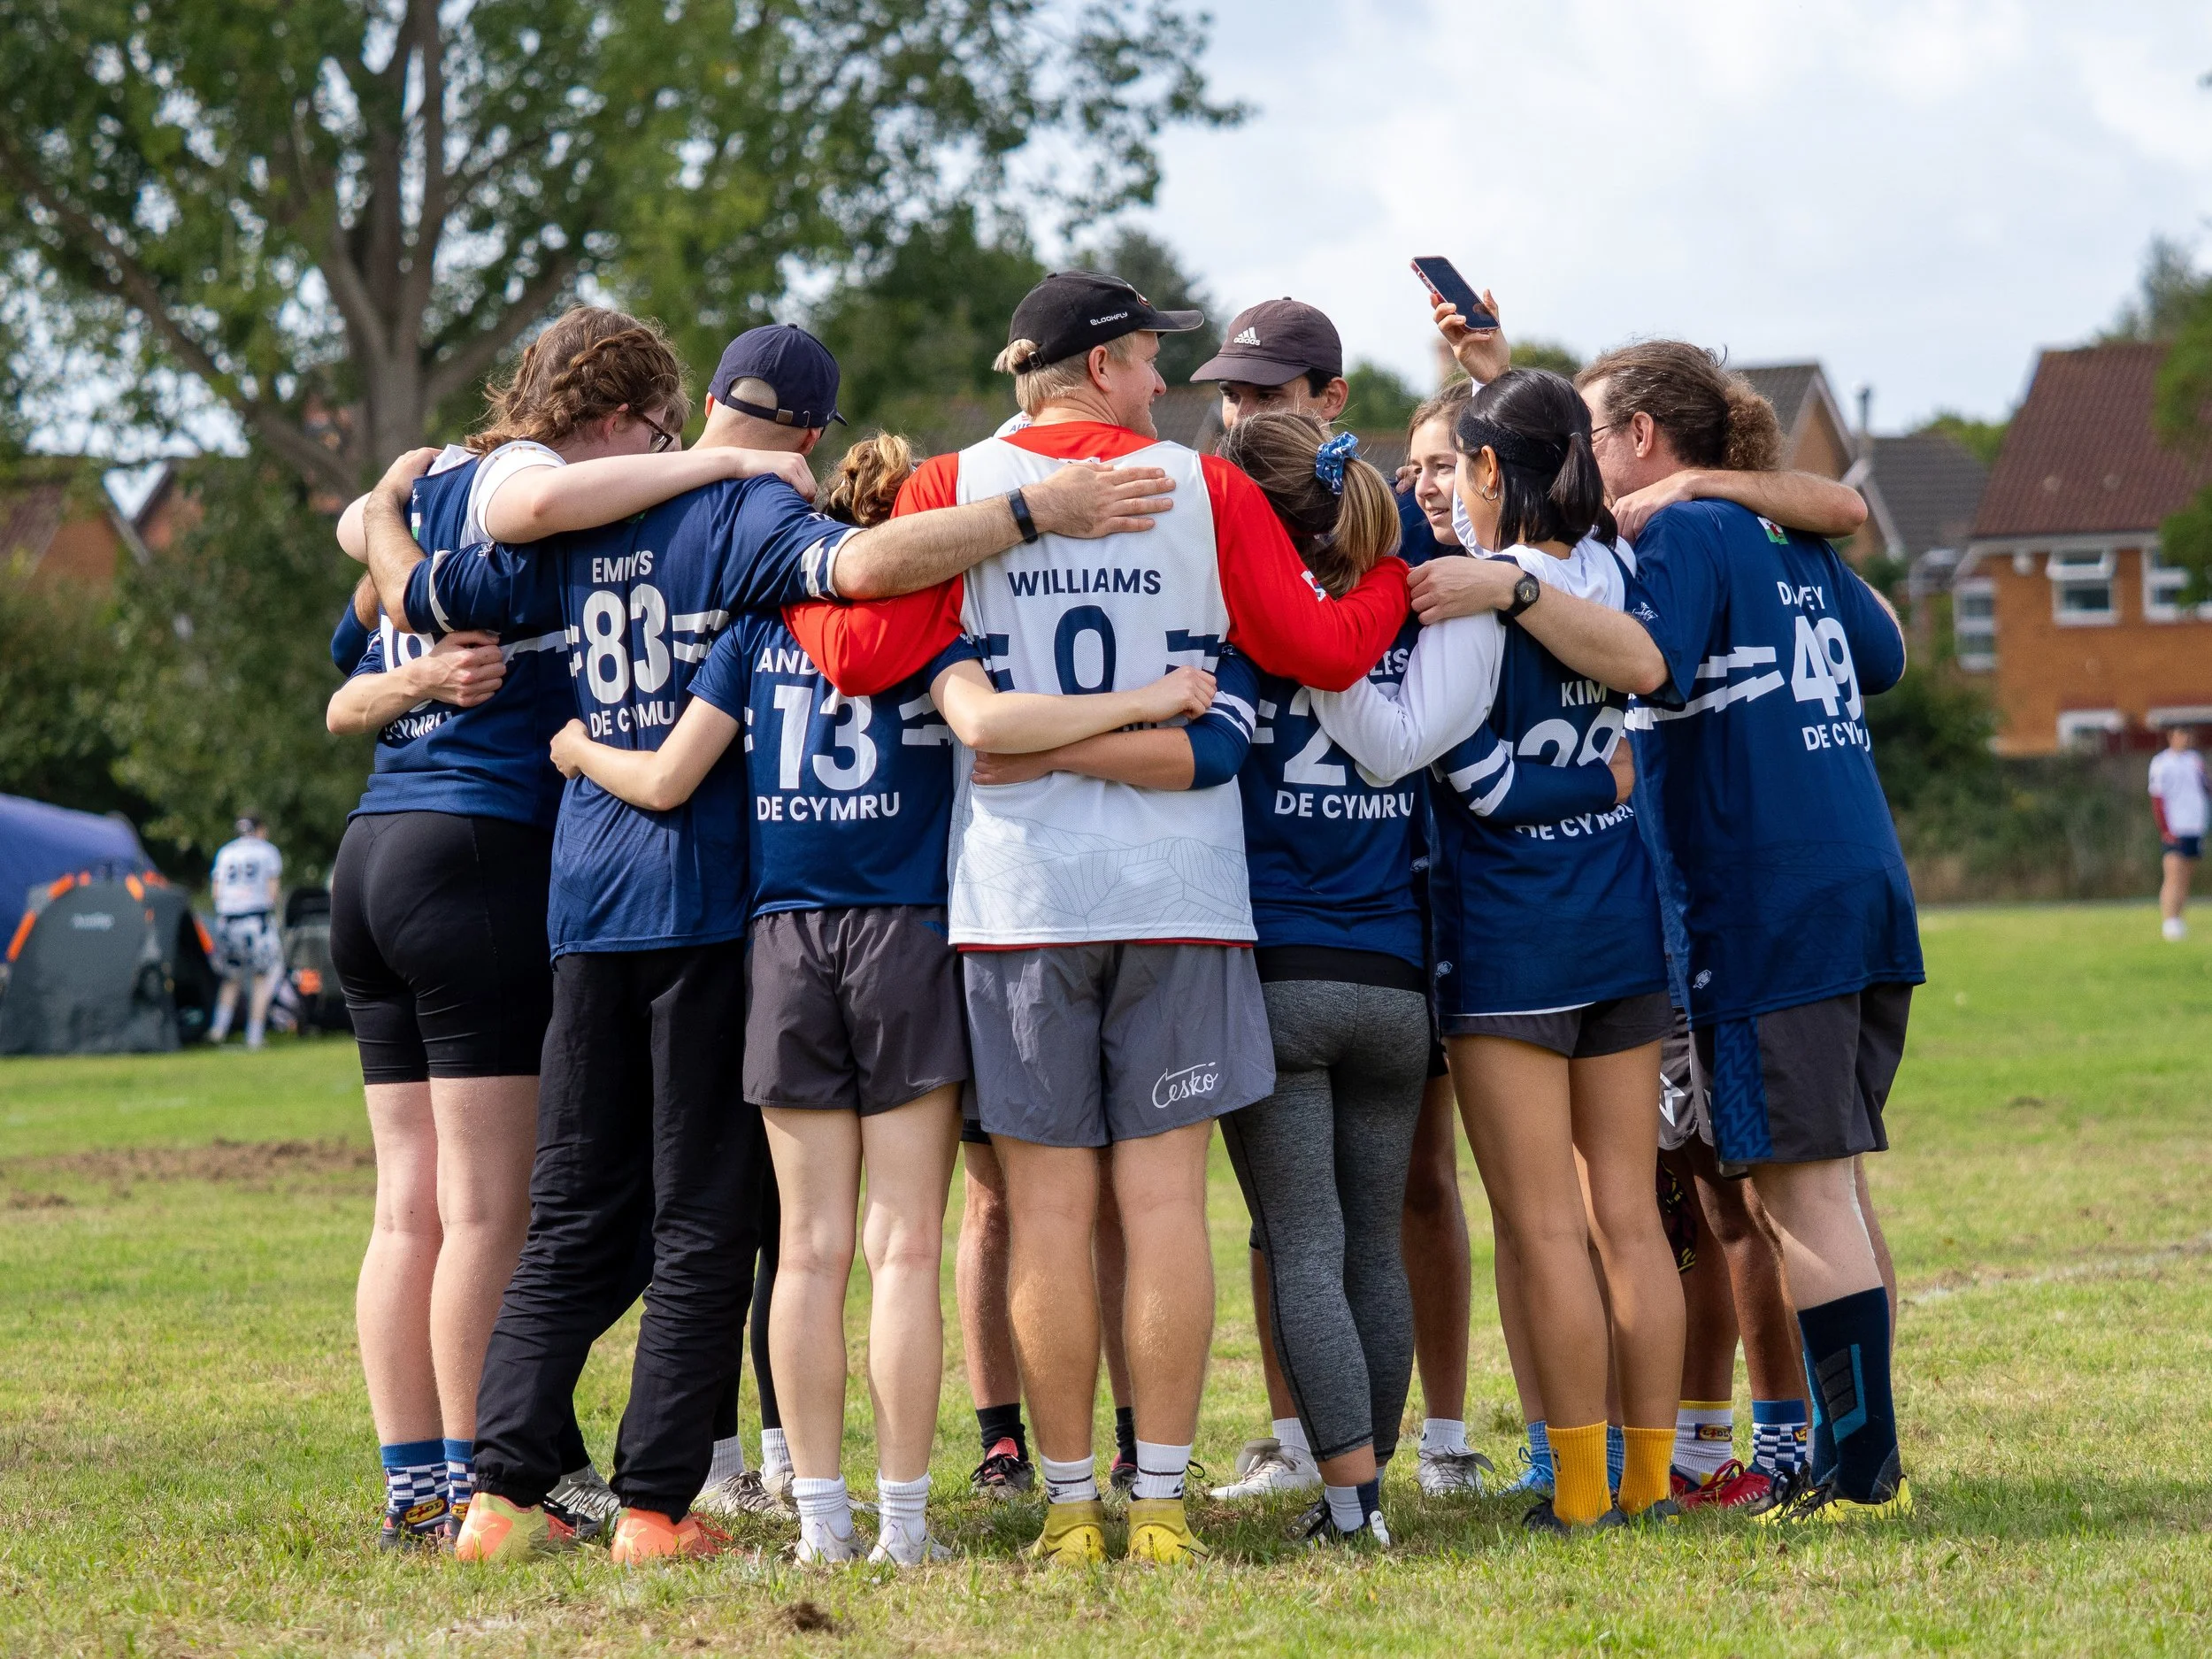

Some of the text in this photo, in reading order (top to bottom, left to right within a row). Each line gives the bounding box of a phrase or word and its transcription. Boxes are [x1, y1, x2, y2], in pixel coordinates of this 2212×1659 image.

[1233, 337, 1261, 346] adidas
[1007, 568, 1162, 597] WILLIAMS
[583, 584, 671, 704] 83
[1054, 605, 1117, 695] 0
[756, 647, 825, 676] AND
[1791, 616, 1863, 721] 49
[1561, 680, 1608, 707] KIM
[590, 710, 612, 738] DE
[773, 685, 877, 791] 13
[1801, 724, 1831, 751] DE
[757, 792, 900, 822] DE CYMRU
[1275, 790, 1415, 819] DE CYMRU
